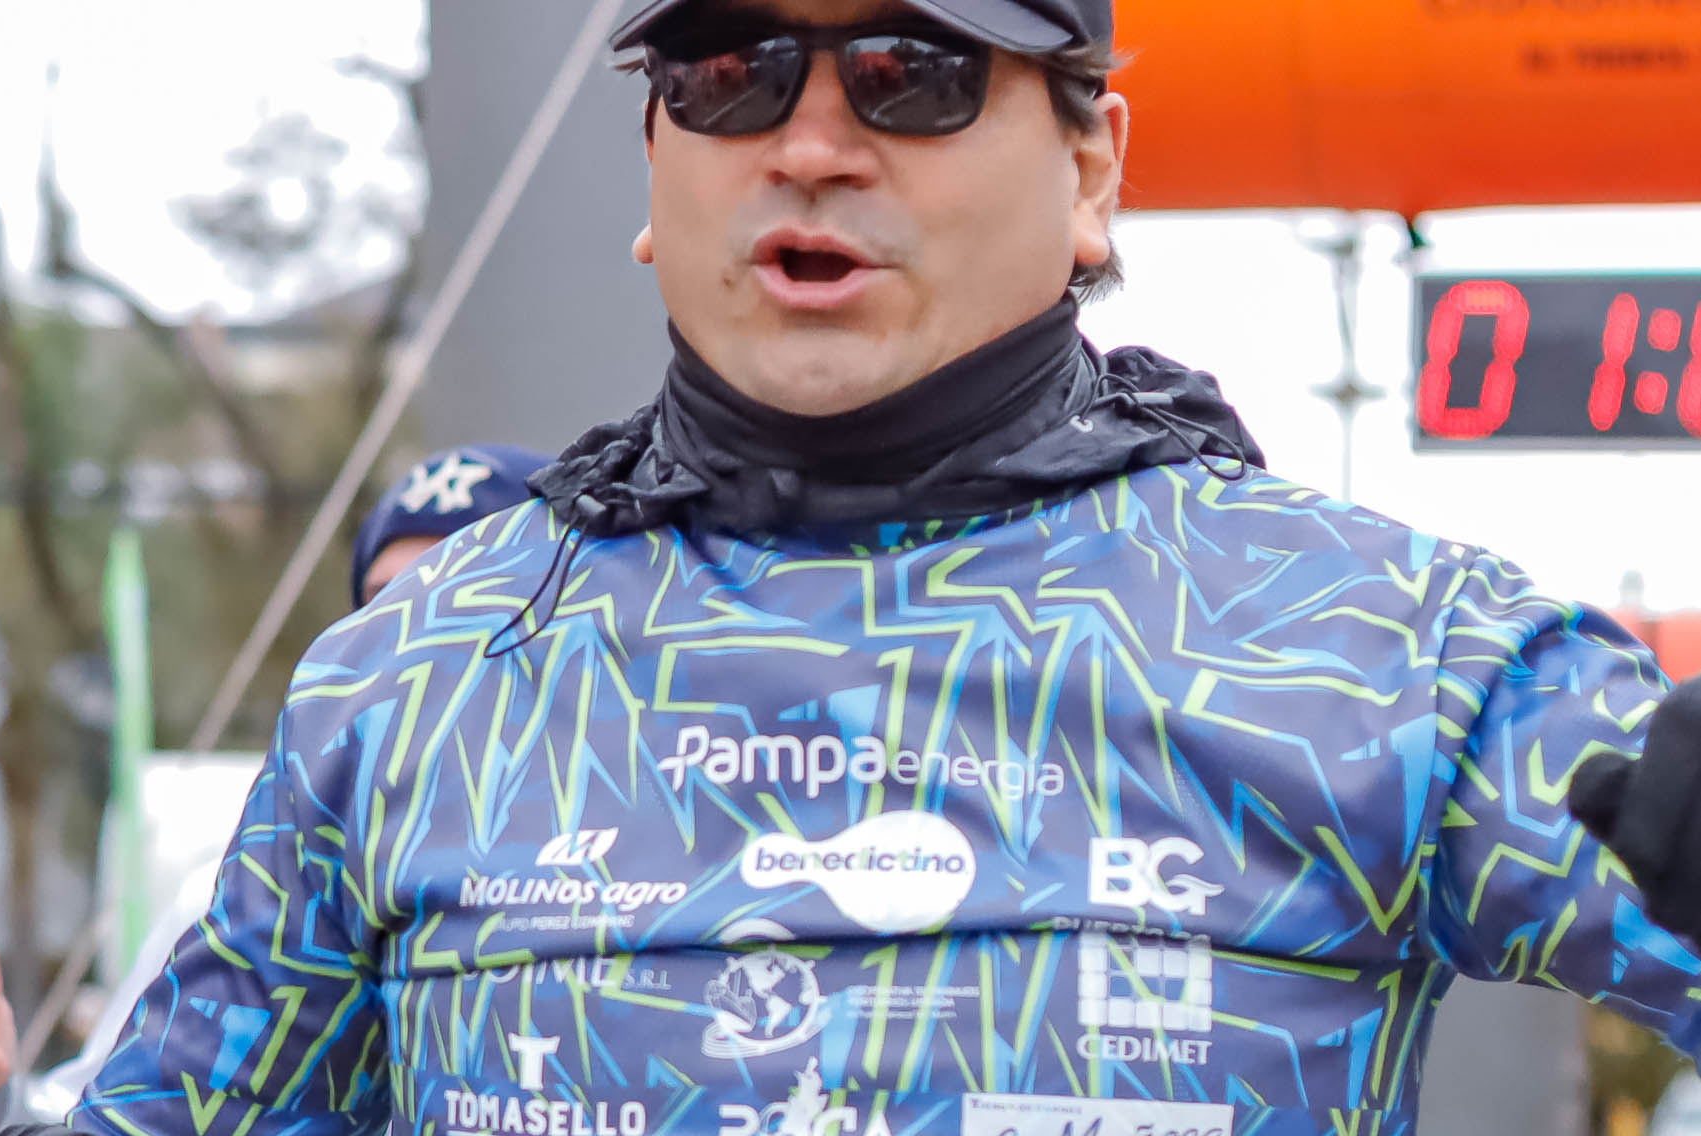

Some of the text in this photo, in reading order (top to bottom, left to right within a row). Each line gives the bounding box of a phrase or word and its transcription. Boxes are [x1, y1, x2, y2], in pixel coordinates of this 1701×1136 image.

[1416, 280, 1701, 441] 01:
[755, 847, 965, 876] benedictino
[1088, 836, 1226, 916] BG
[459, 876, 688, 912] MOLINOS agro
[1076, 1032, 1213, 1066] CEDIMET
